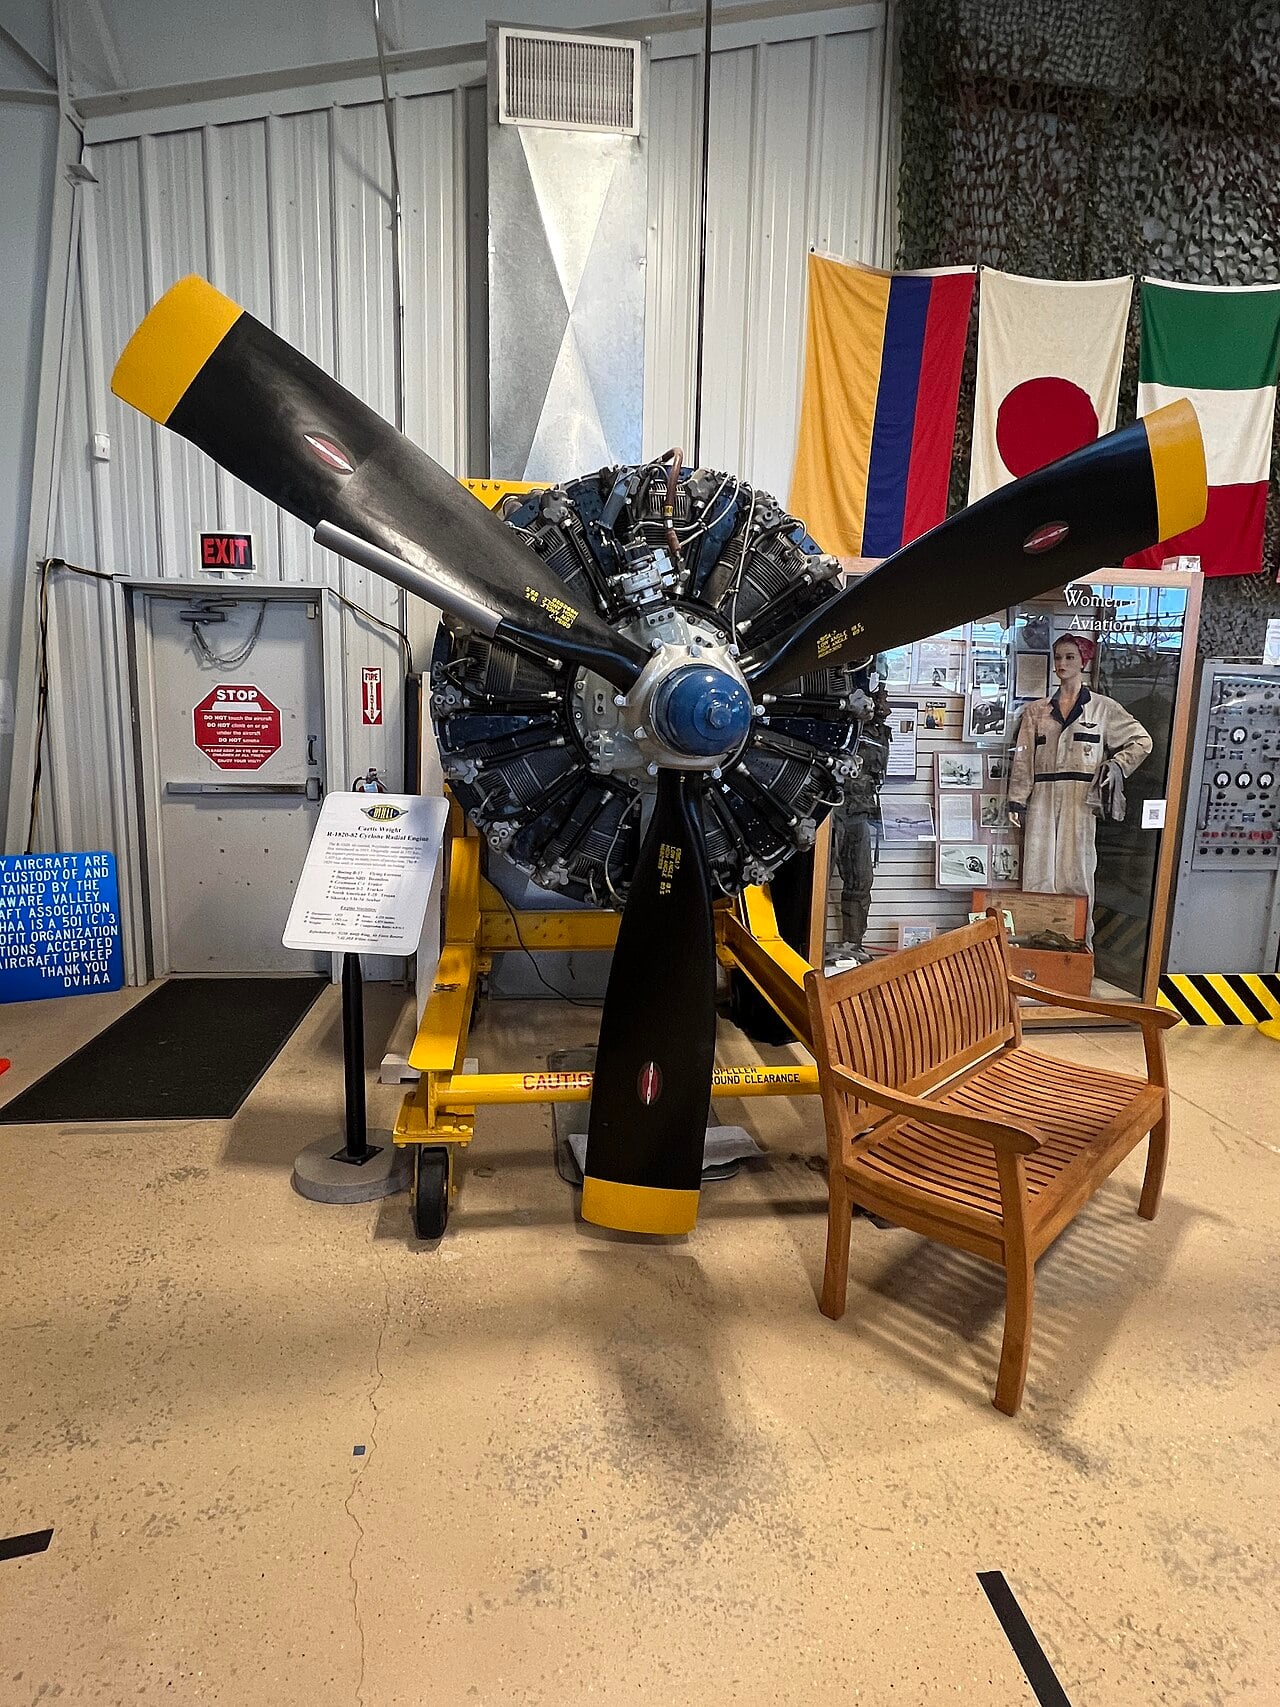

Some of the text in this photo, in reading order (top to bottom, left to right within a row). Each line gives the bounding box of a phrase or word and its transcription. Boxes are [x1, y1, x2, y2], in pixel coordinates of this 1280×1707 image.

[204, 538, 248, 564] EXIT
[1068, 614, 1133, 632] Aviation
[216, 690, 258, 700] STOP
[15, 857, 77, 870] AIRCRAFT
[85, 855, 109, 866] ARE
[4, 867, 108, 883] CUSTODY OF AND
[1, 880, 99, 896] TAINED BY THE
[0, 891, 99, 908] AWARE VALLEY
[29, 902, 110, 918] ASSOCIATION
[0, 920, 24, 932] HAA
[32, 919, 43, 930] IS
[48, 918, 56, 929] A
[63, 916, 81, 927] 501
[109, 913, 115, 924] 3
[0, 925, 118, 945] OFIT ORGANIZATION
[0, 938, 112, 957] TIONS ACCEPTED
[64, 949, 112, 963] UPKEEP
[40, 961, 107, 978] THANK YOU
[64, 973, 110, 988] DVHAA
[524, 1073, 592, 1090] CAUTIO
[714, 1074, 800, 1084] OUND CLEARANCE
